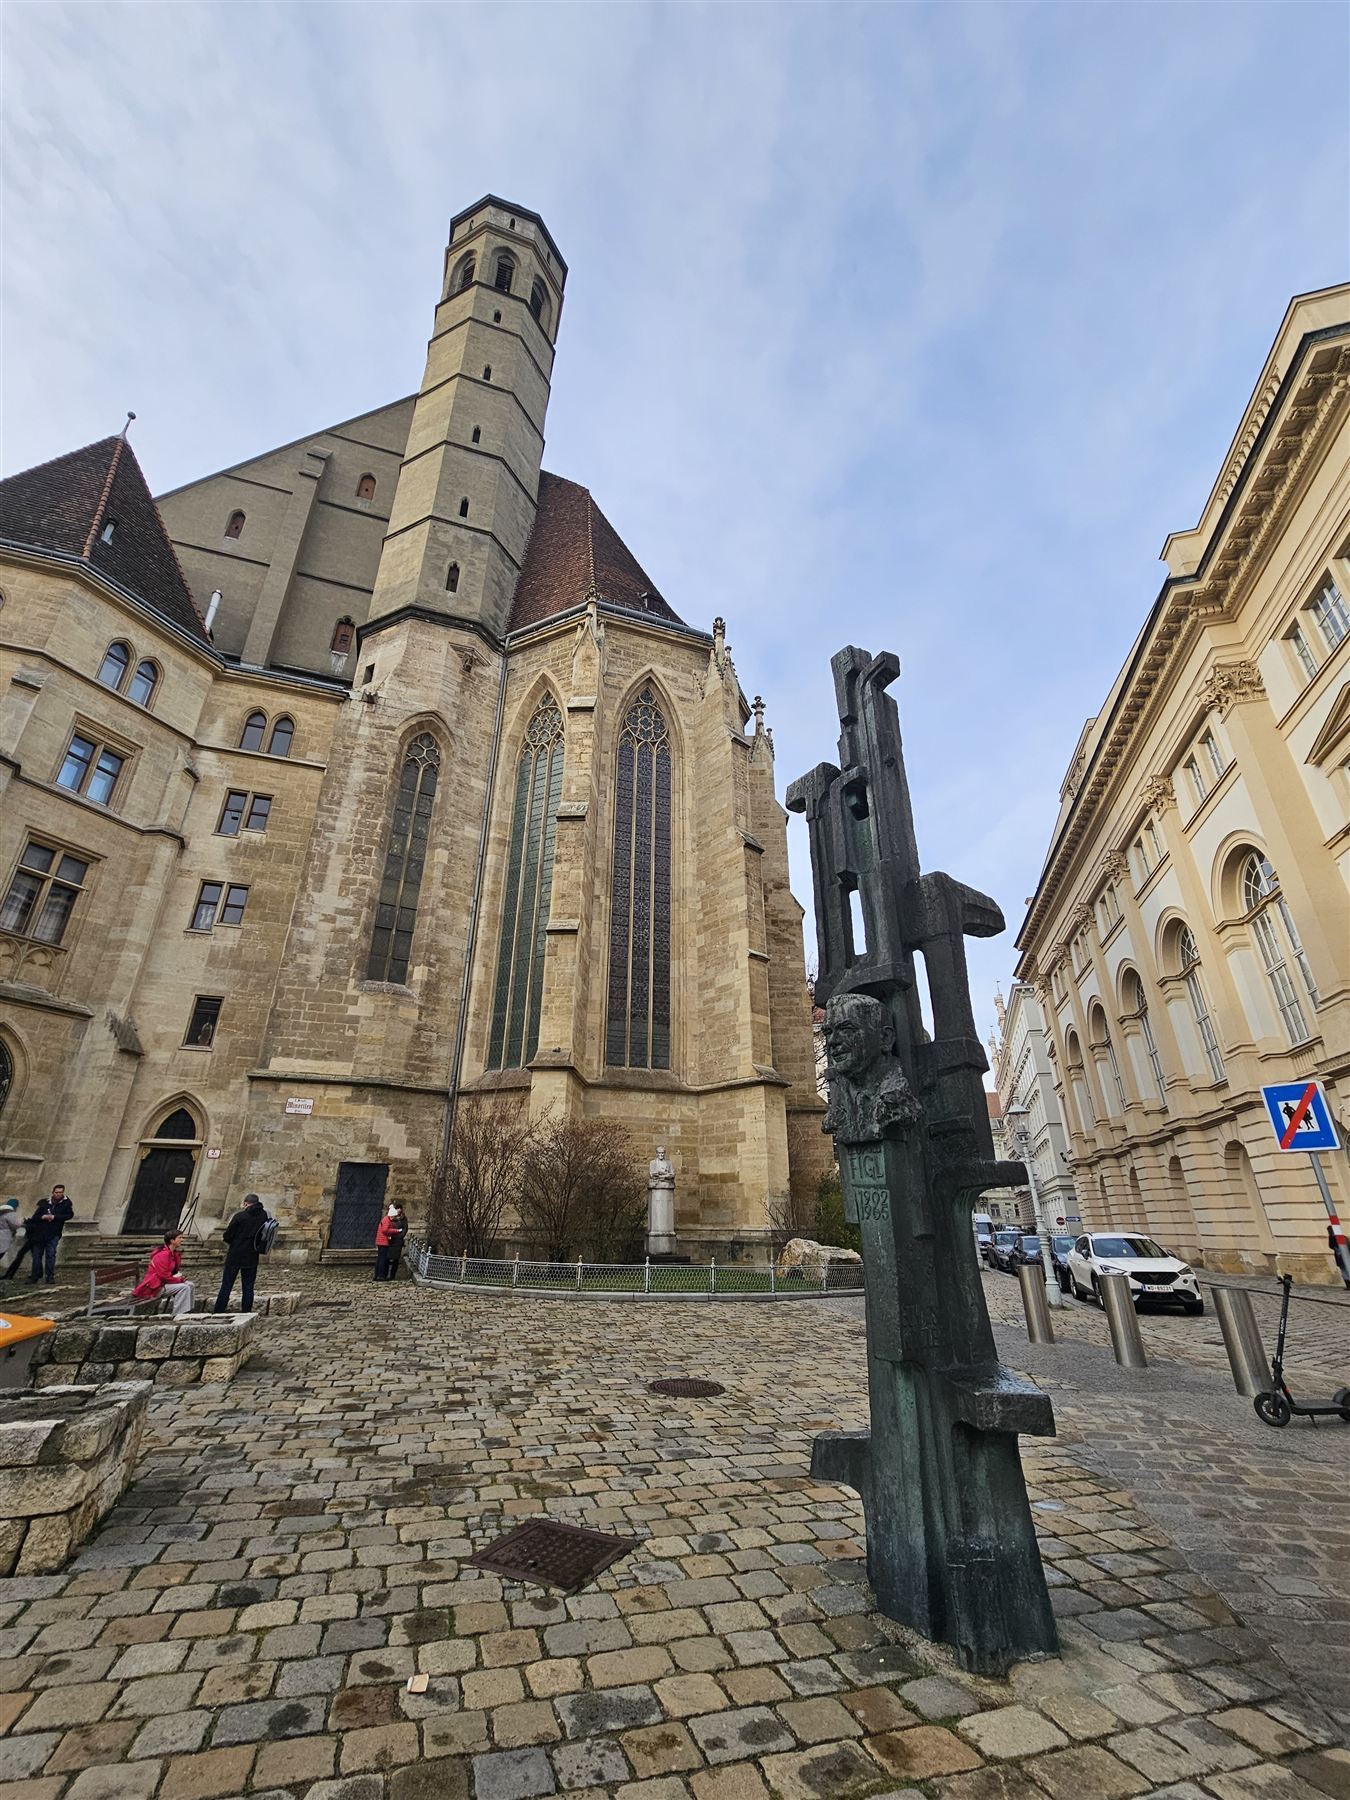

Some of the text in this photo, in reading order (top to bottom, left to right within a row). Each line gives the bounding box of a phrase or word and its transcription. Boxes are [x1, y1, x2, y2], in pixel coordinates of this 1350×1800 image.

[849, 1155, 884, 1180] FIGL
[859, 1190, 888, 1206] 1902
[860, 1203, 889, 1221] 1965
